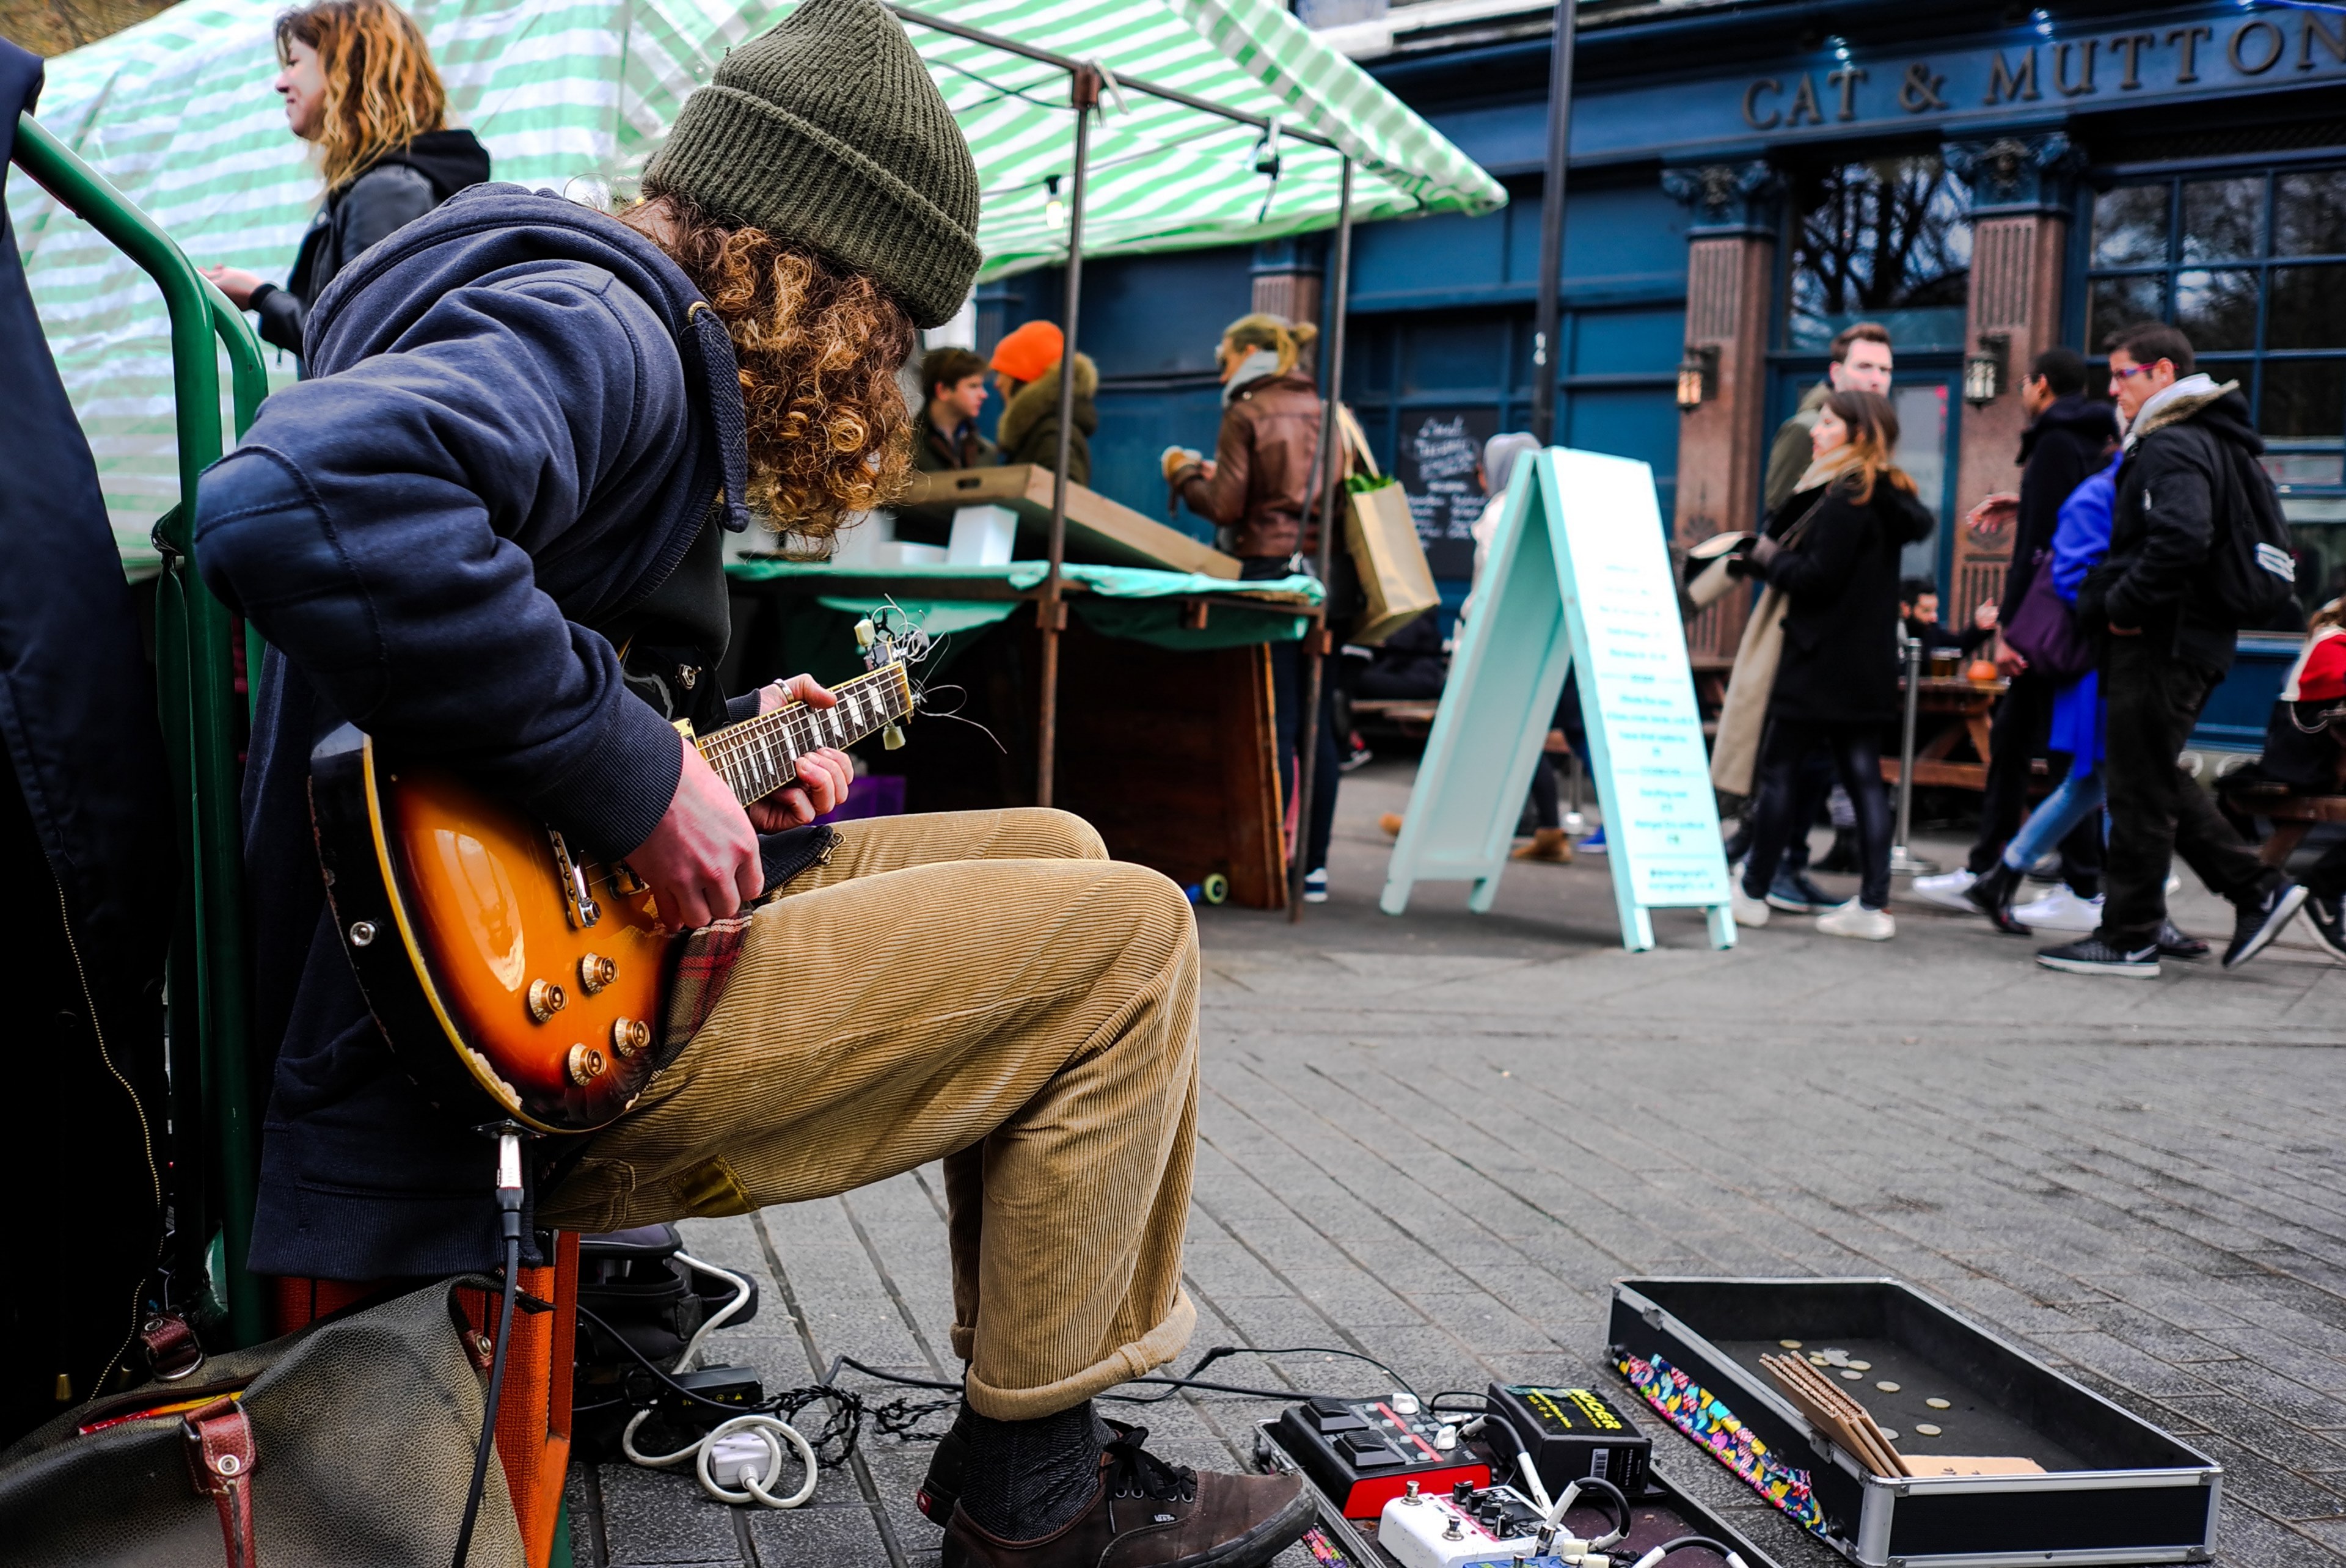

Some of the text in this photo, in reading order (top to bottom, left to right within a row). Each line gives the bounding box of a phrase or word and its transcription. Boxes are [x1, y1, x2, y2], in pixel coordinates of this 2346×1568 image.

[1742, 9, 2346, 130] CAT & MUTTON
